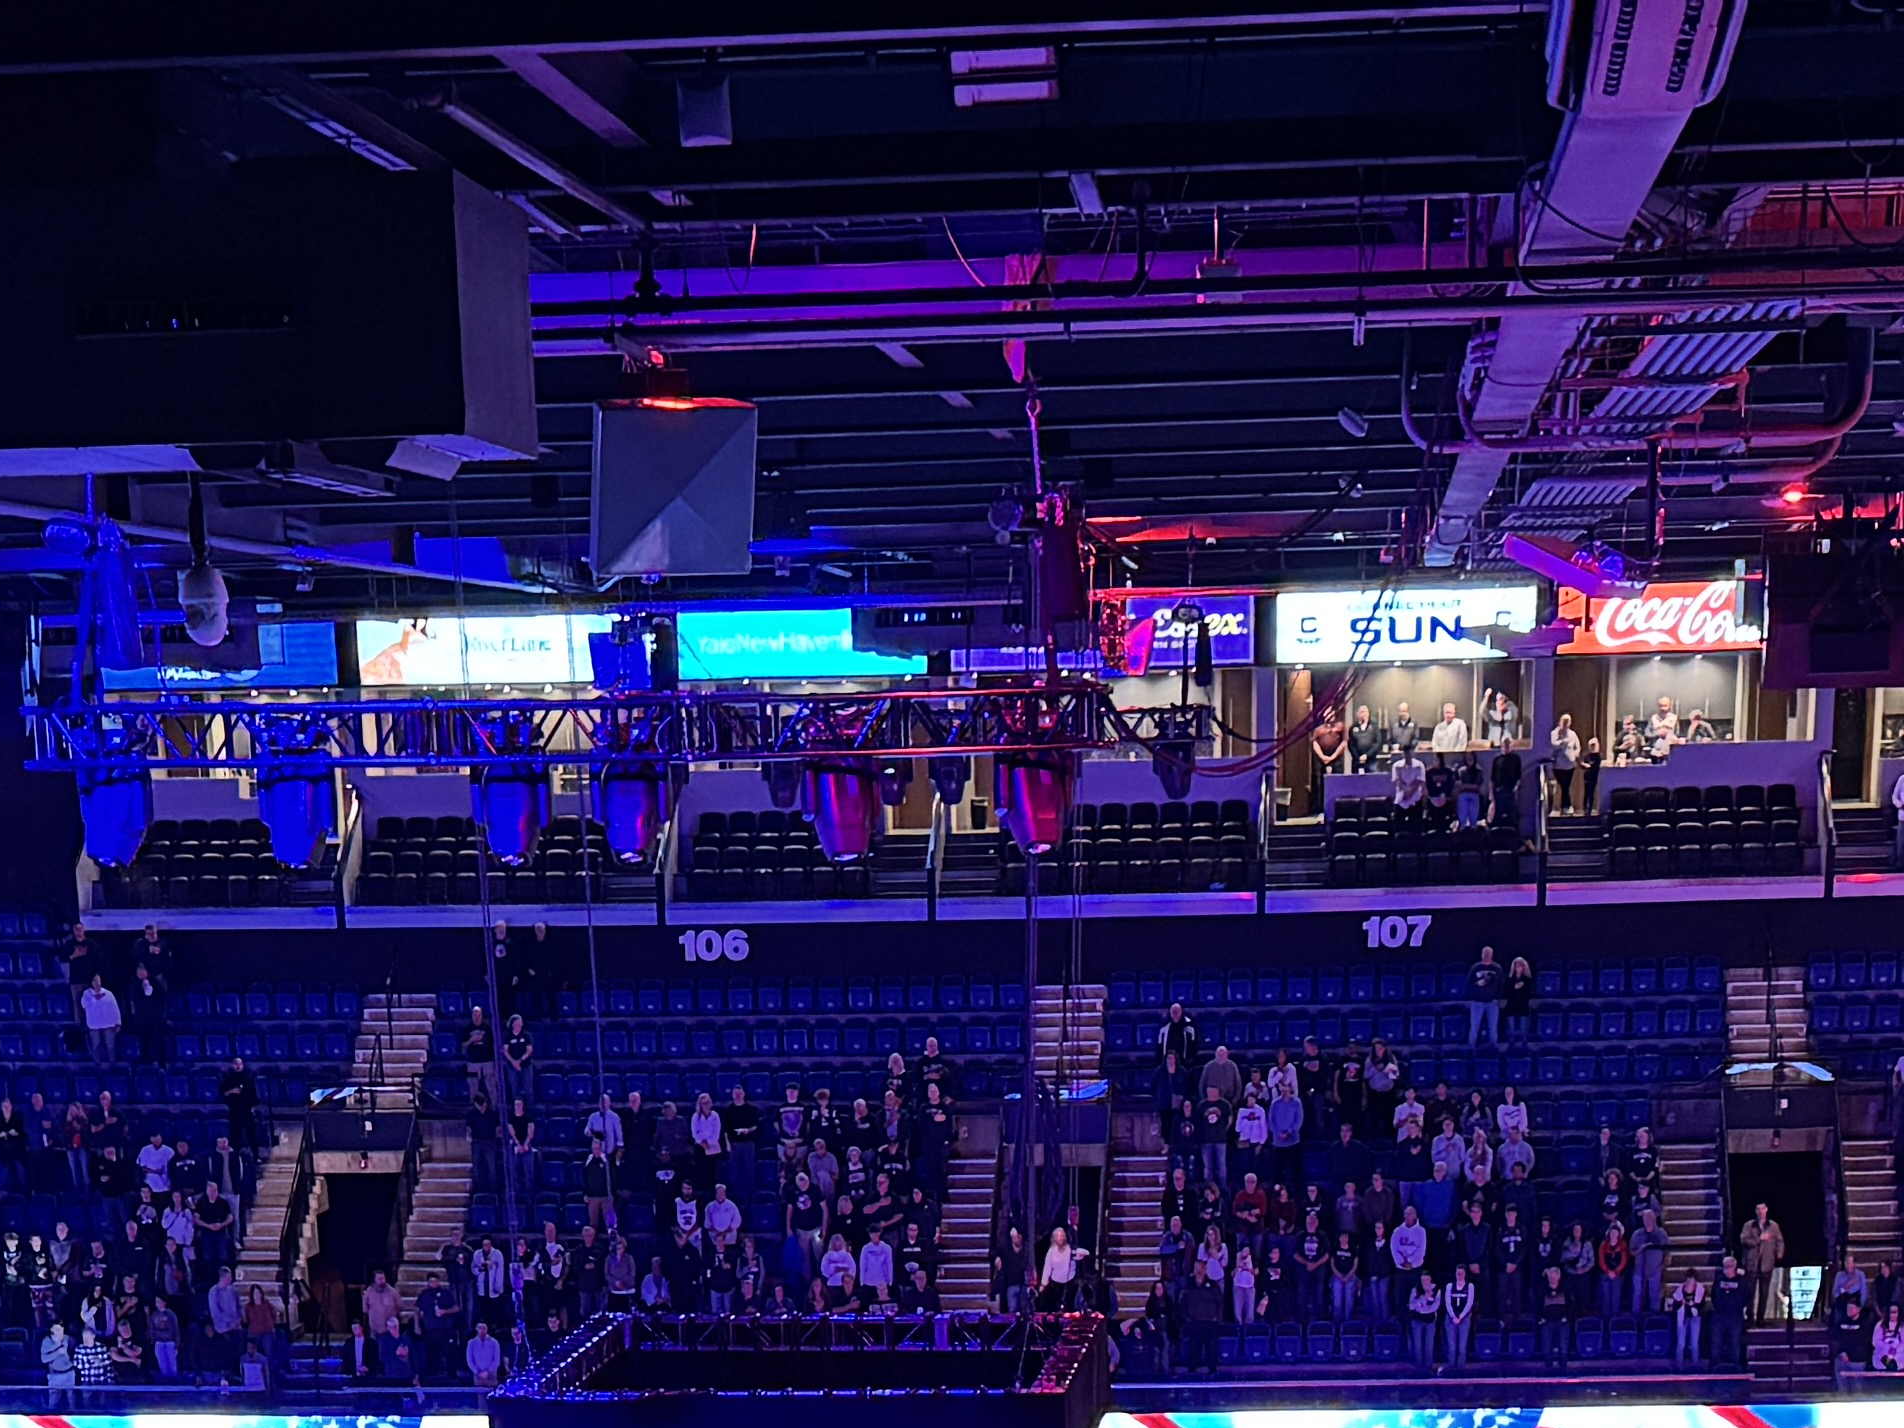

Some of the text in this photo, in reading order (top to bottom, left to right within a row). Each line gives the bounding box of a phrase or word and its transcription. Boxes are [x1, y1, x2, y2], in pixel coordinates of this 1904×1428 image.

[1350, 615, 1462, 644] SUN
[679, 929, 749, 962] 106
[1363, 915, 1432, 948] 107
